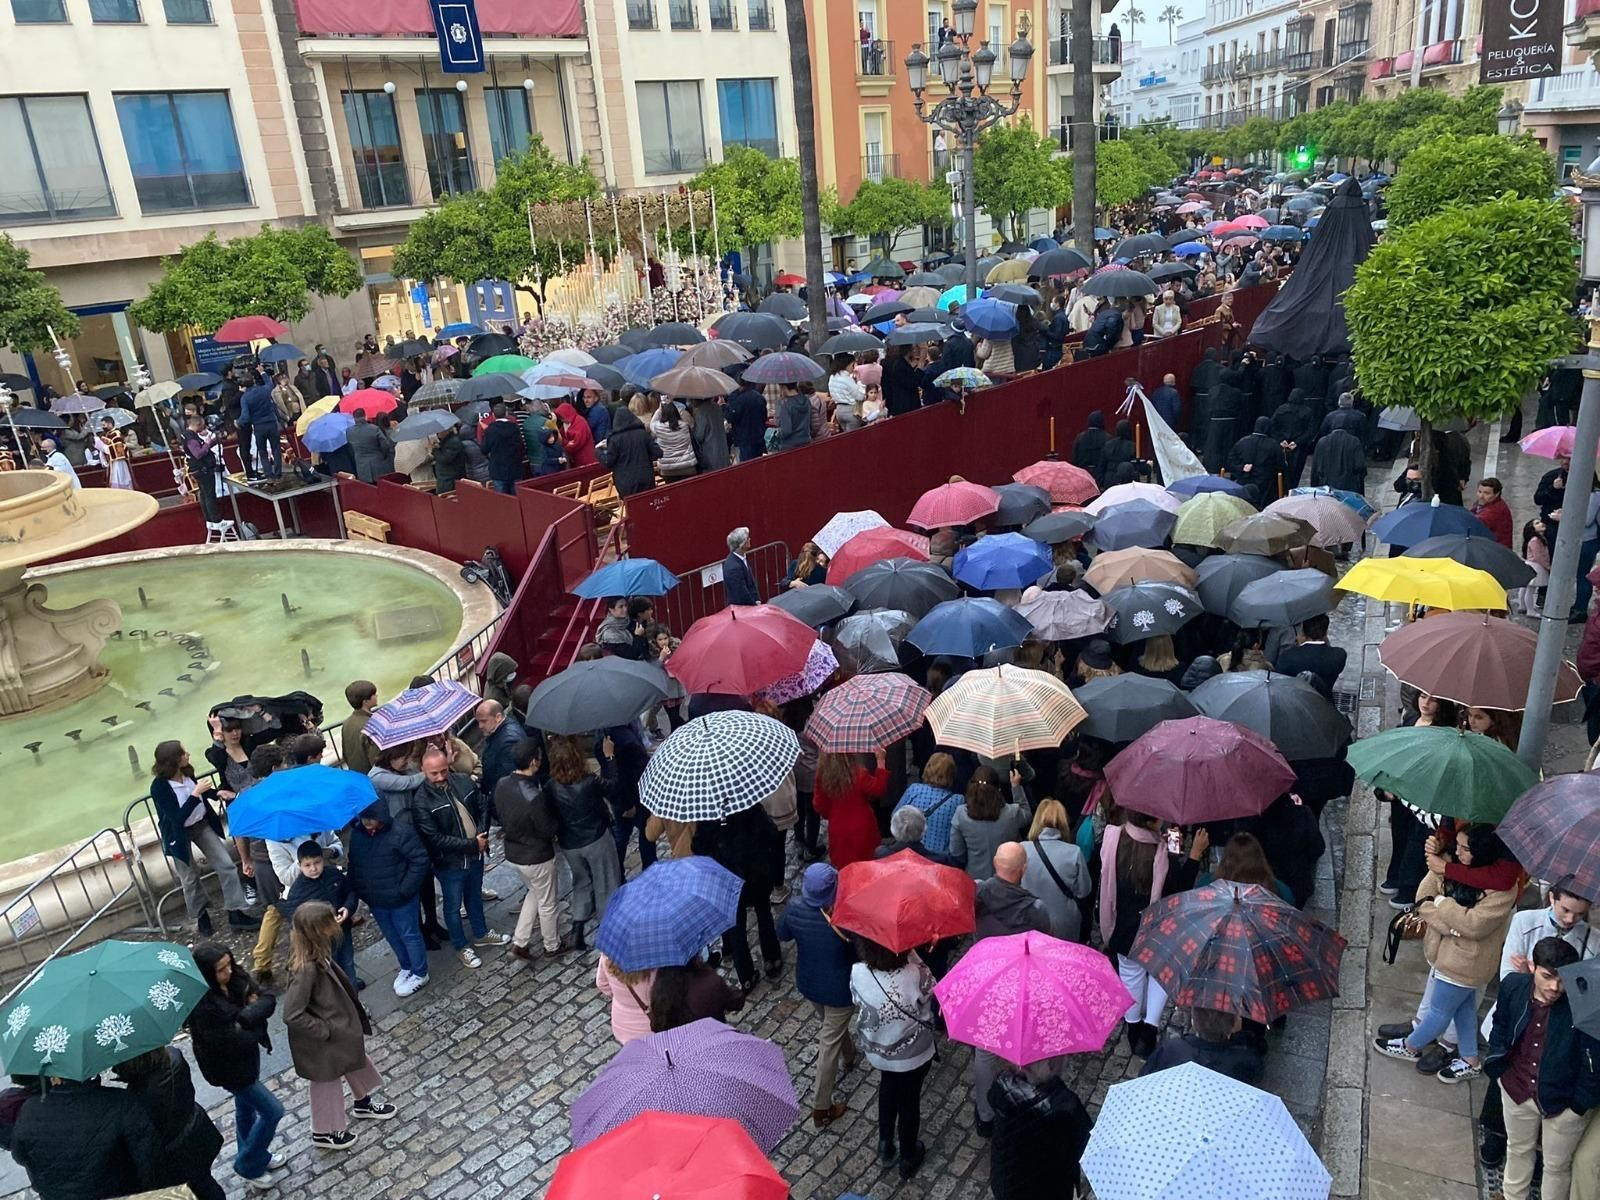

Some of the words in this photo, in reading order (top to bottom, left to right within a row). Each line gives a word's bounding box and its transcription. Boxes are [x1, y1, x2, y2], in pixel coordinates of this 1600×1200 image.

[1488, 42, 1555, 60] PELUQUERÍA
[1516, 56, 1525, 65] &
[1486, 63, 1554, 79] ESTÉTICA
